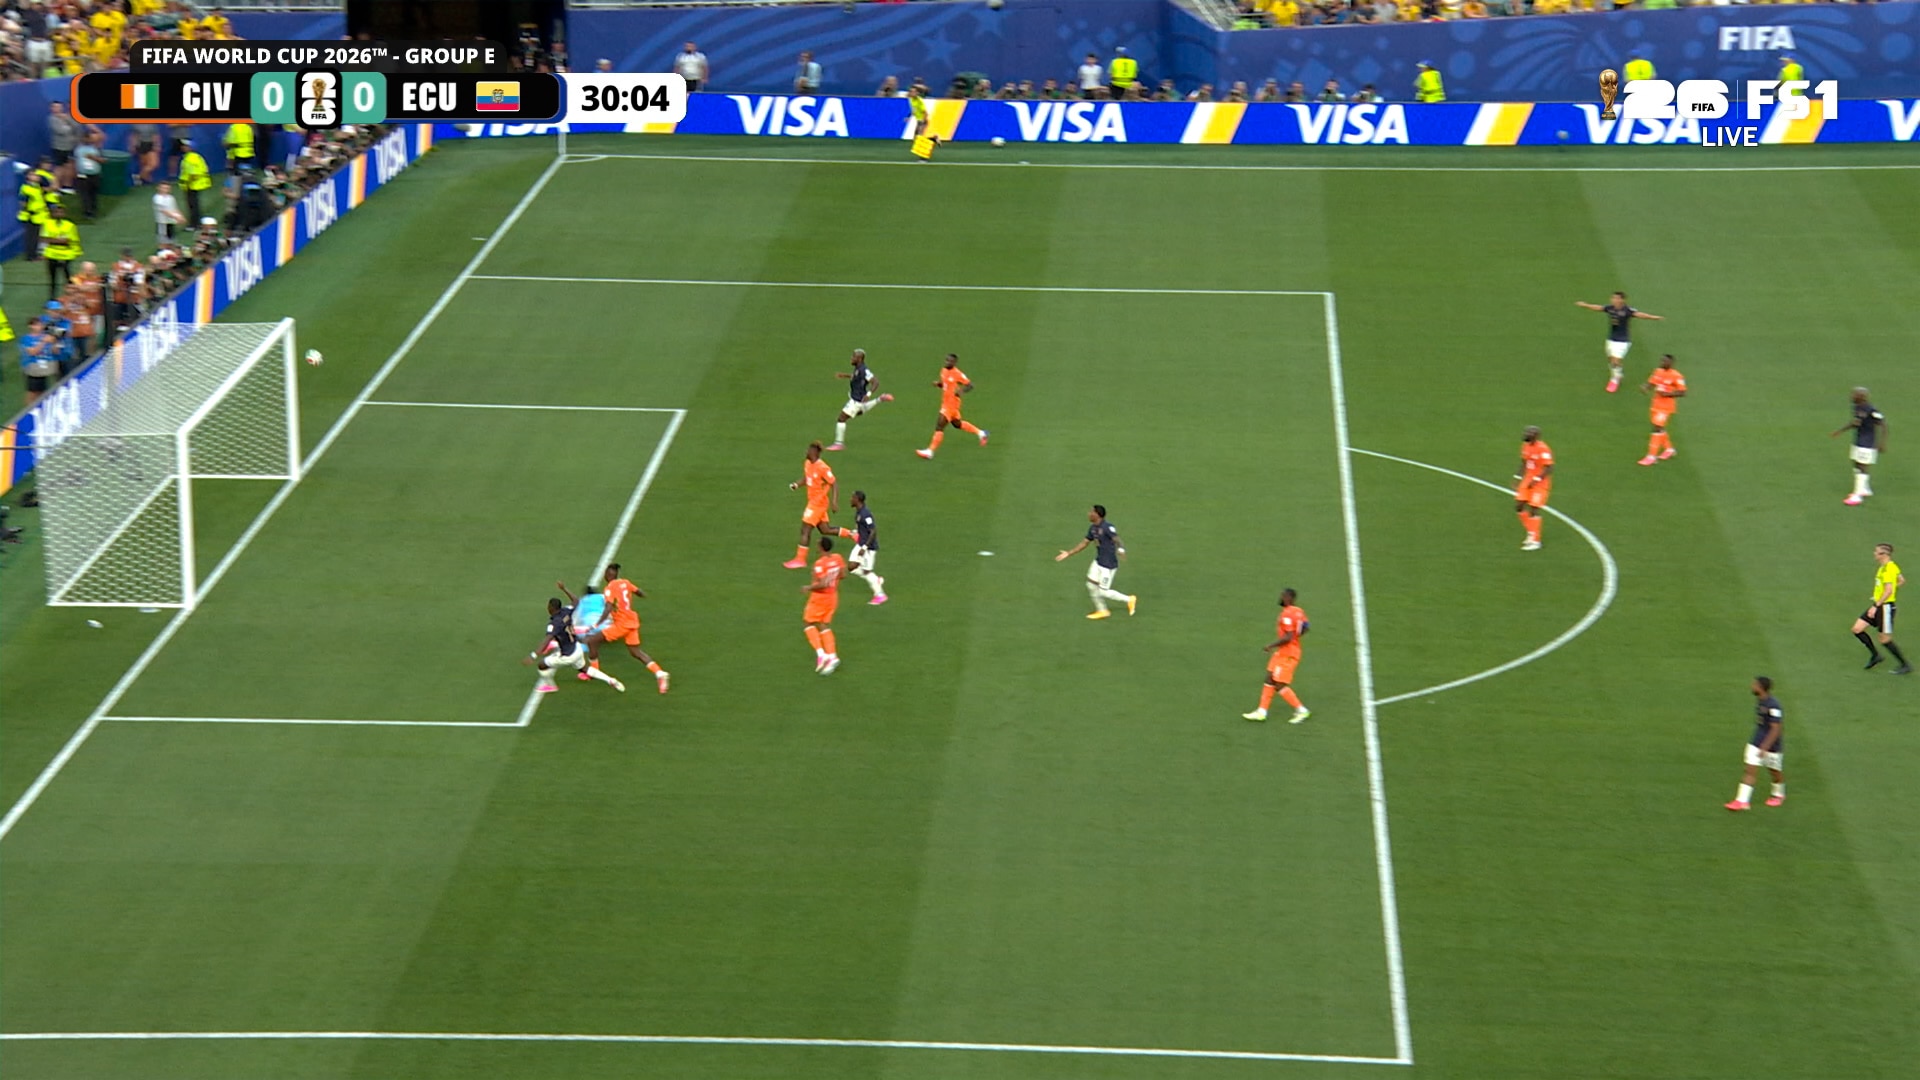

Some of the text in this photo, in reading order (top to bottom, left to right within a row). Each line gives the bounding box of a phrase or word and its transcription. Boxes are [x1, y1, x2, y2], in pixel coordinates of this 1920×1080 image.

[1718, 26, 1796, 51] FIFA
[726, 95, 849, 137] VISA
[1004, 101, 1127, 142] VISA
[1284, 103, 1410, 144] VISA
[371, 127, 409, 185] VISA
[300, 178, 338, 240] VISA
[222, 235, 264, 301] VISA
